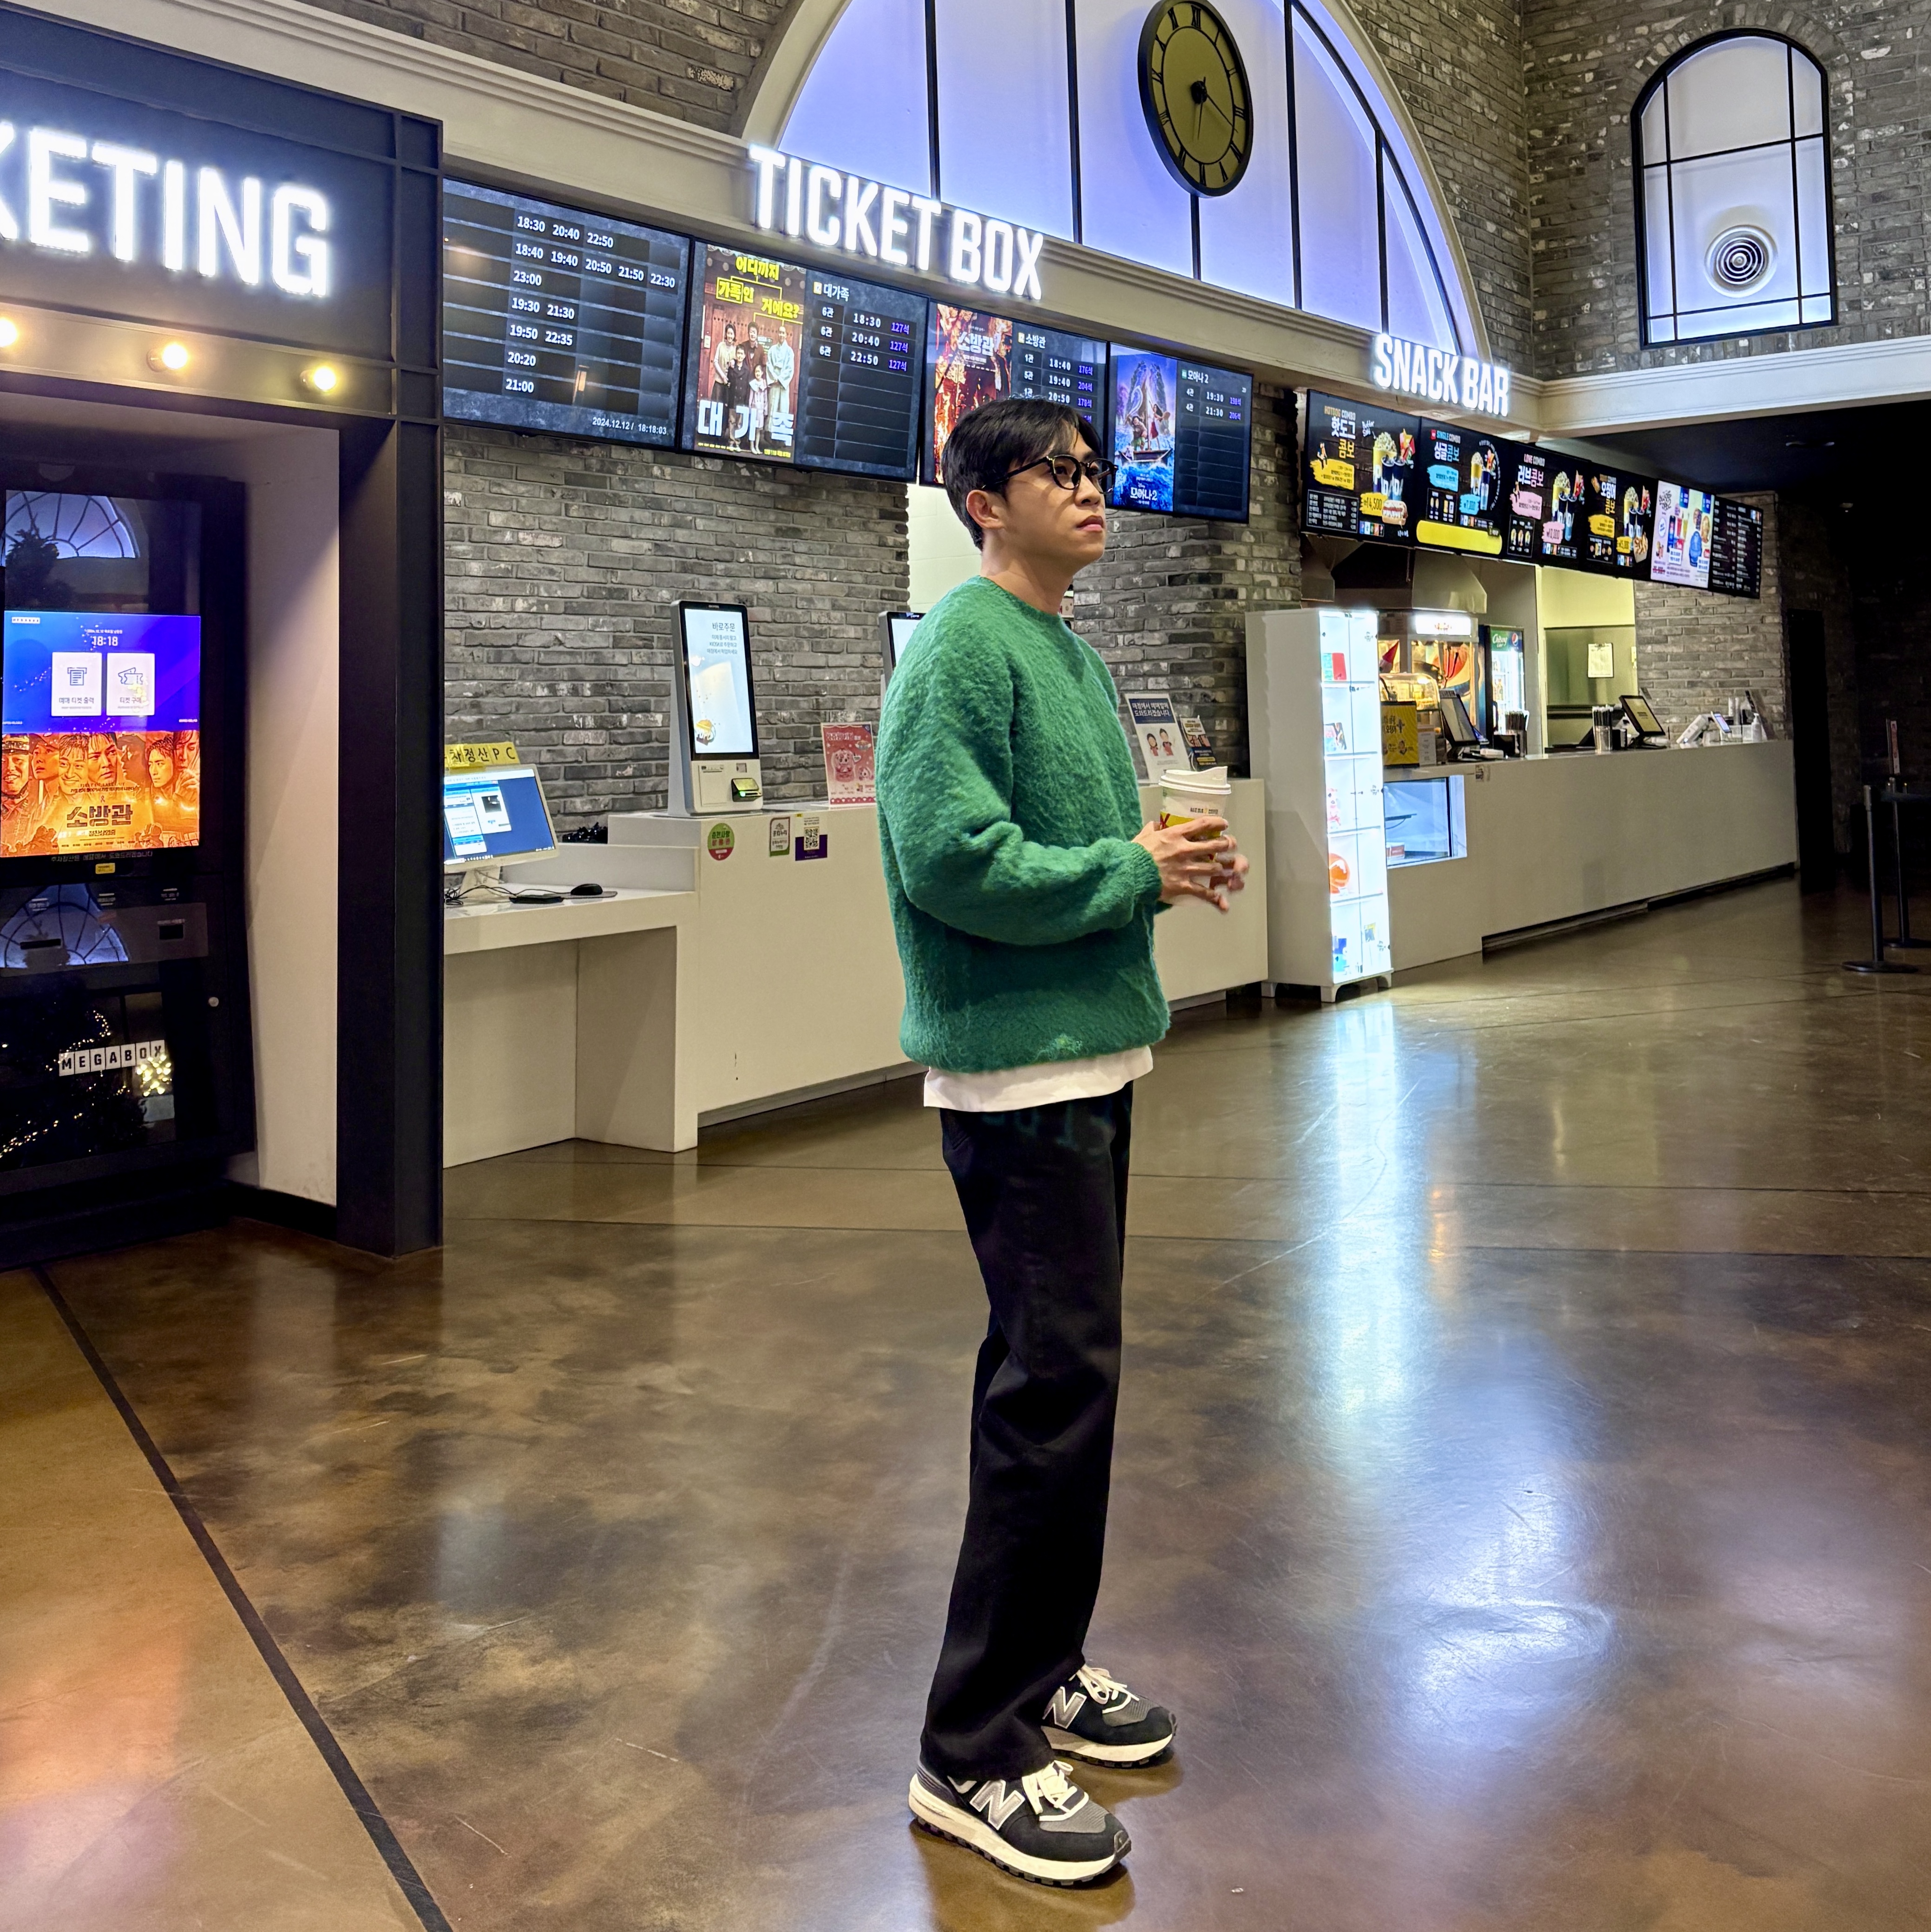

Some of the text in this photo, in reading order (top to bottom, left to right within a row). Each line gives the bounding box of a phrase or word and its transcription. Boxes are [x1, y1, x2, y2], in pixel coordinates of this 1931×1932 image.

[517, 216, 613, 248] 18:30 20:40 22:50
[749, 145, 1044, 300] TICKET BOX
[515, 243, 675, 288] 18:40 19:40 20:50 21:50 22:30
[736, 256, 779, 281] 어디까지
[513, 270, 542, 286] 23:00
[823, 283, 850, 302] 대가족
[512, 297, 575, 320] 19:30 21:30
[761, 298, 800, 319] 거예요?
[822, 307, 910, 335] 6관 18:30 127석
[510, 324, 572, 346] 19:50 22:35
[821, 326, 908, 353] 6관 20:40 127석
[958, 331, 995, 356] 소방관
[1025, 333, 1046, 348] 소방관
[507, 351, 536, 367] 20:20
[819, 346, 907, 372] 6관 22:50 127석
[1049, 358, 1071, 371] 18:40
[506, 378, 534, 393] 21:00
[1049, 375, 1071, 388] 19:40
[1188, 370, 1209, 384] 모아나 2
[1375, 333, 1509, 417] SNACK BAR
[1048, 392, 1070, 404] 20:50
[1206, 392, 1224, 402] 19:30
[1206, 407, 1223, 417] 21:30
[1341, 409, 1356, 420] COMBO
[638, 423, 667, 435] 18:18:03
[1331, 416, 1356, 440] 핫도그
[1338, 438, 1355, 459] 콤보
[1434, 441, 1459, 462] 싱글콤보
[1517, 465, 1544, 487] 러브콤보
[1601, 481, 1616, 500] 오징어
[712, 622, 736, 632] 바로주문
[92, 636, 118, 646] 18:18
[444, 747, 515, 763] 차정산 P C
[66, 804, 133, 828] 소방관
[61, 1045, 162, 1070] MEGABOX
